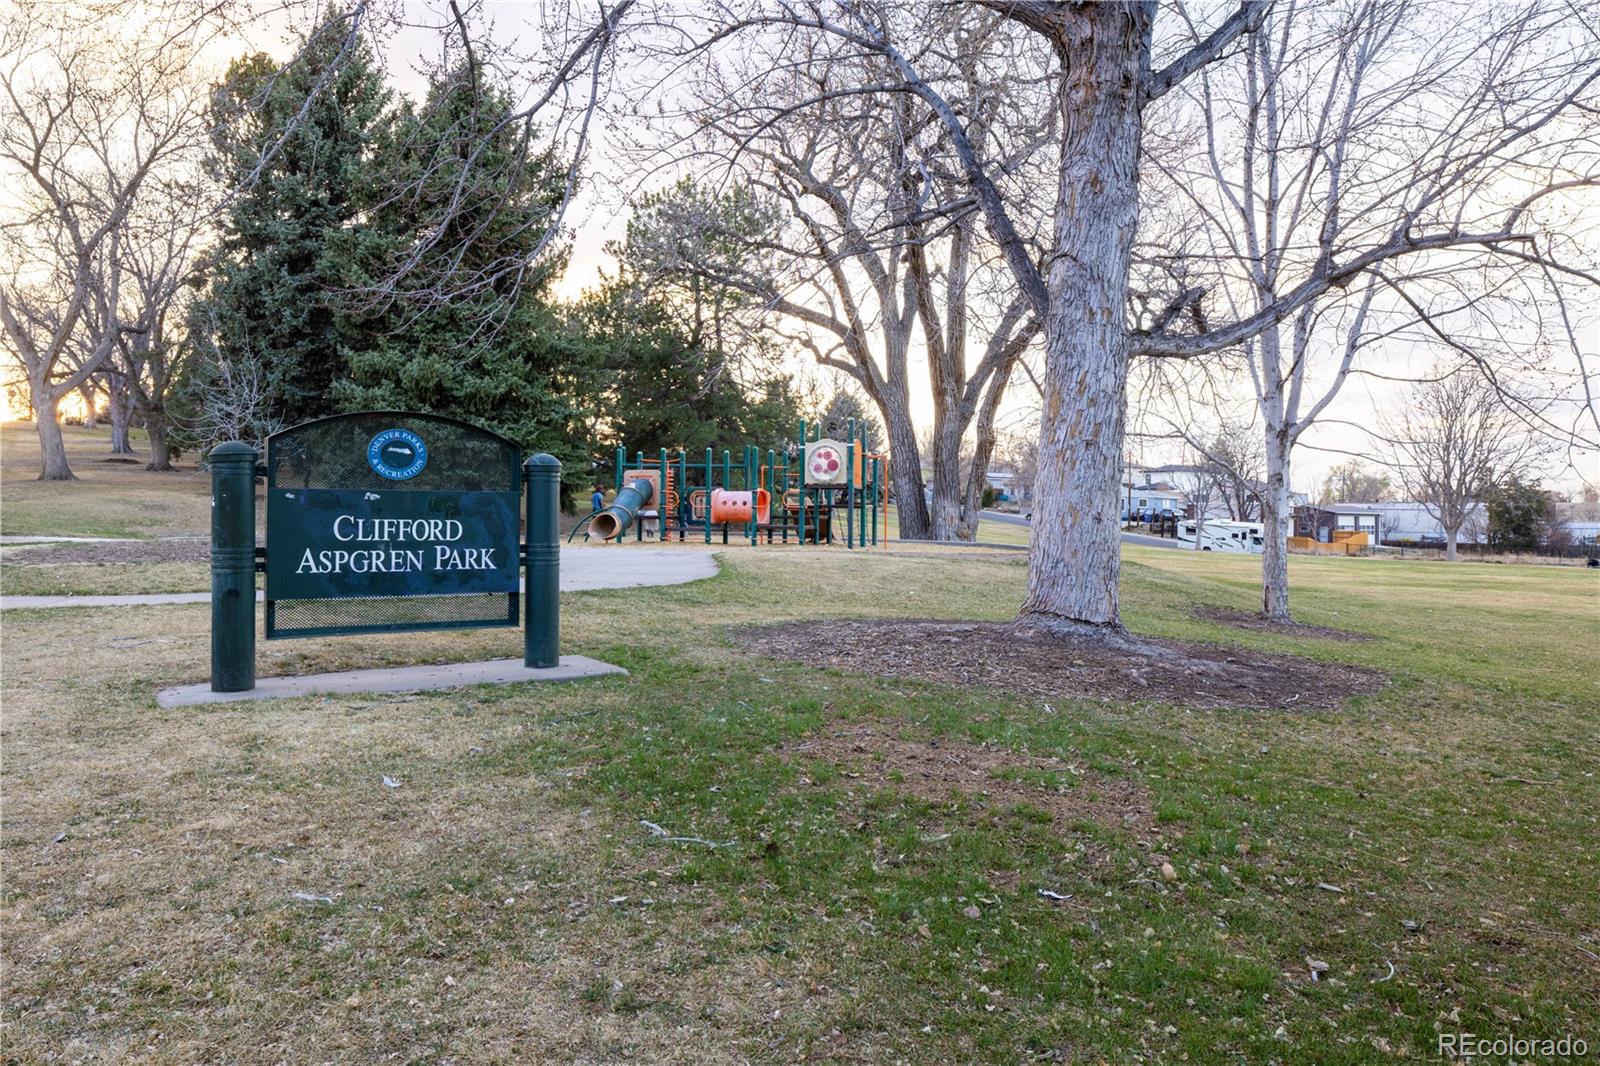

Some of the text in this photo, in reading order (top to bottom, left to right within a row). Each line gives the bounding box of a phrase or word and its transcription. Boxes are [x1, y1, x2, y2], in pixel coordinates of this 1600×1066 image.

[371, 431, 424, 453] DENVER PARKS
[376, 459, 424, 478] RECREATION
[333, 515, 463, 541] CLIFFORD
[296, 546, 497, 573] ASPGREN PARK
